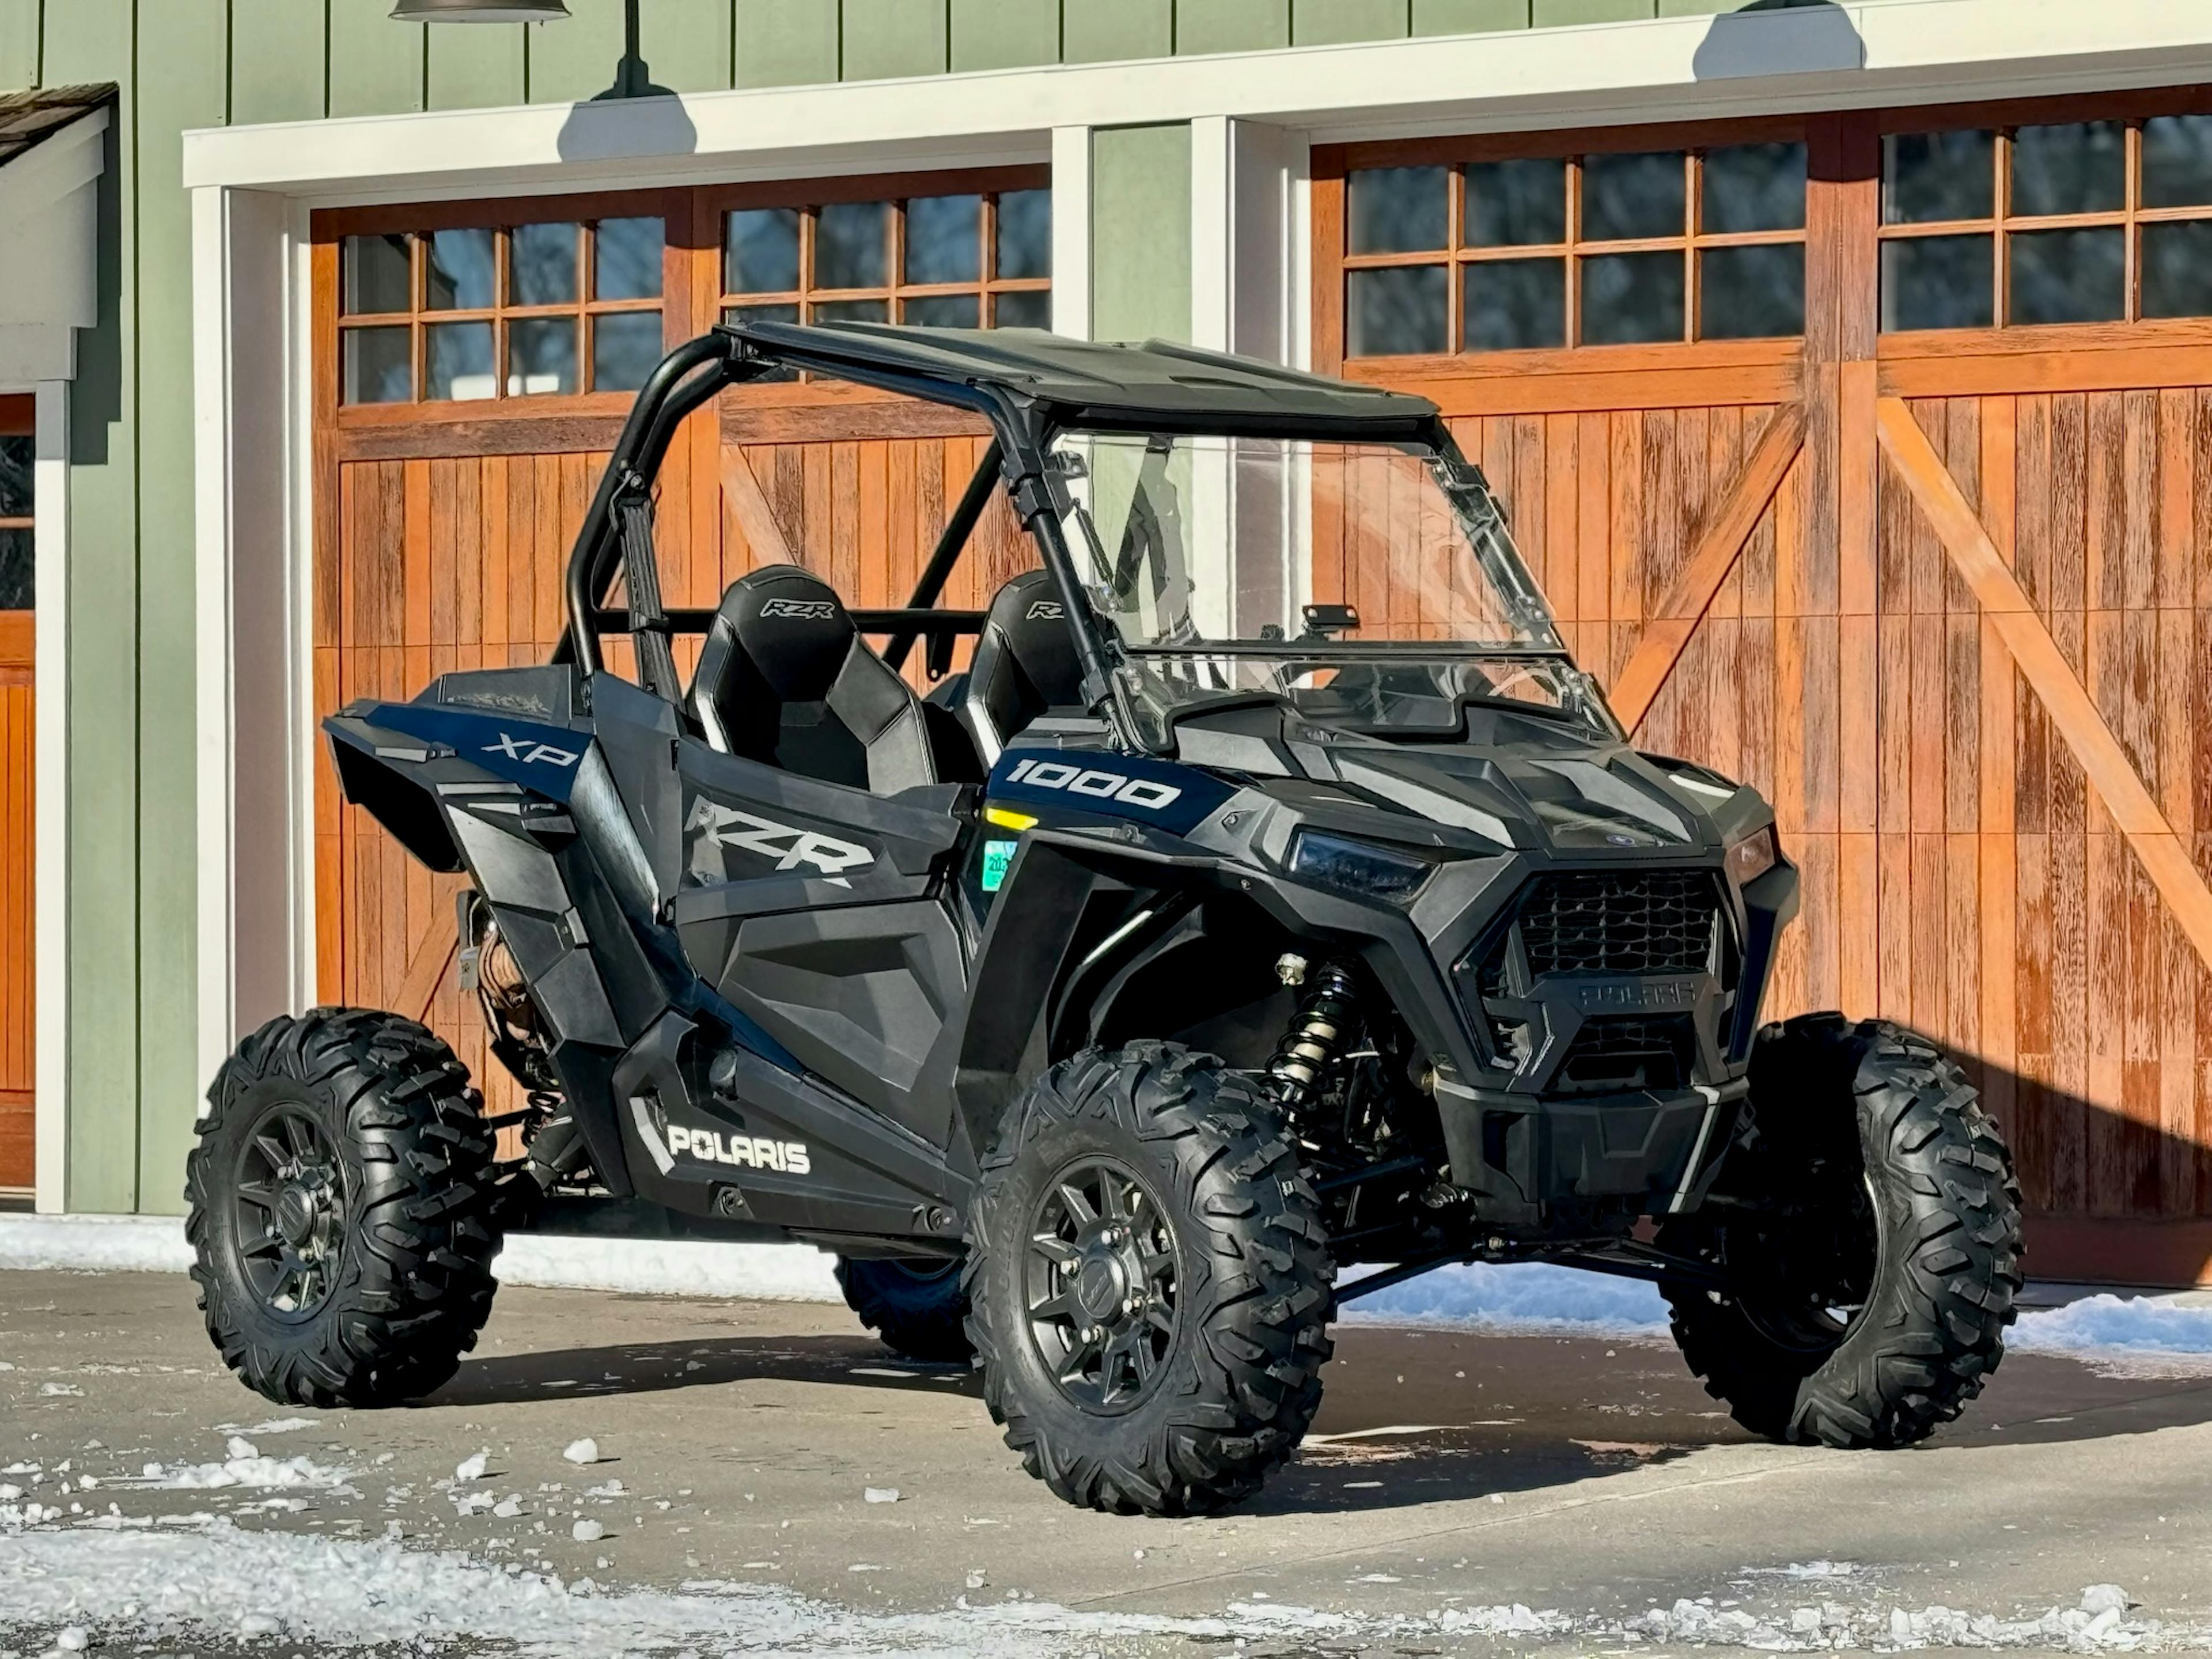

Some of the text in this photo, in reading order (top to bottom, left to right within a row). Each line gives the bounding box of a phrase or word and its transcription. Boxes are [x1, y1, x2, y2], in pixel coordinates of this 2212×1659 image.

[760, 598, 836, 620] RZR
[1026, 601, 1065, 620] RZ
[481, 732, 579, 767] XP
[1006, 759, 1181, 809] 1000
[668, 1125, 811, 1175] POLARIS
